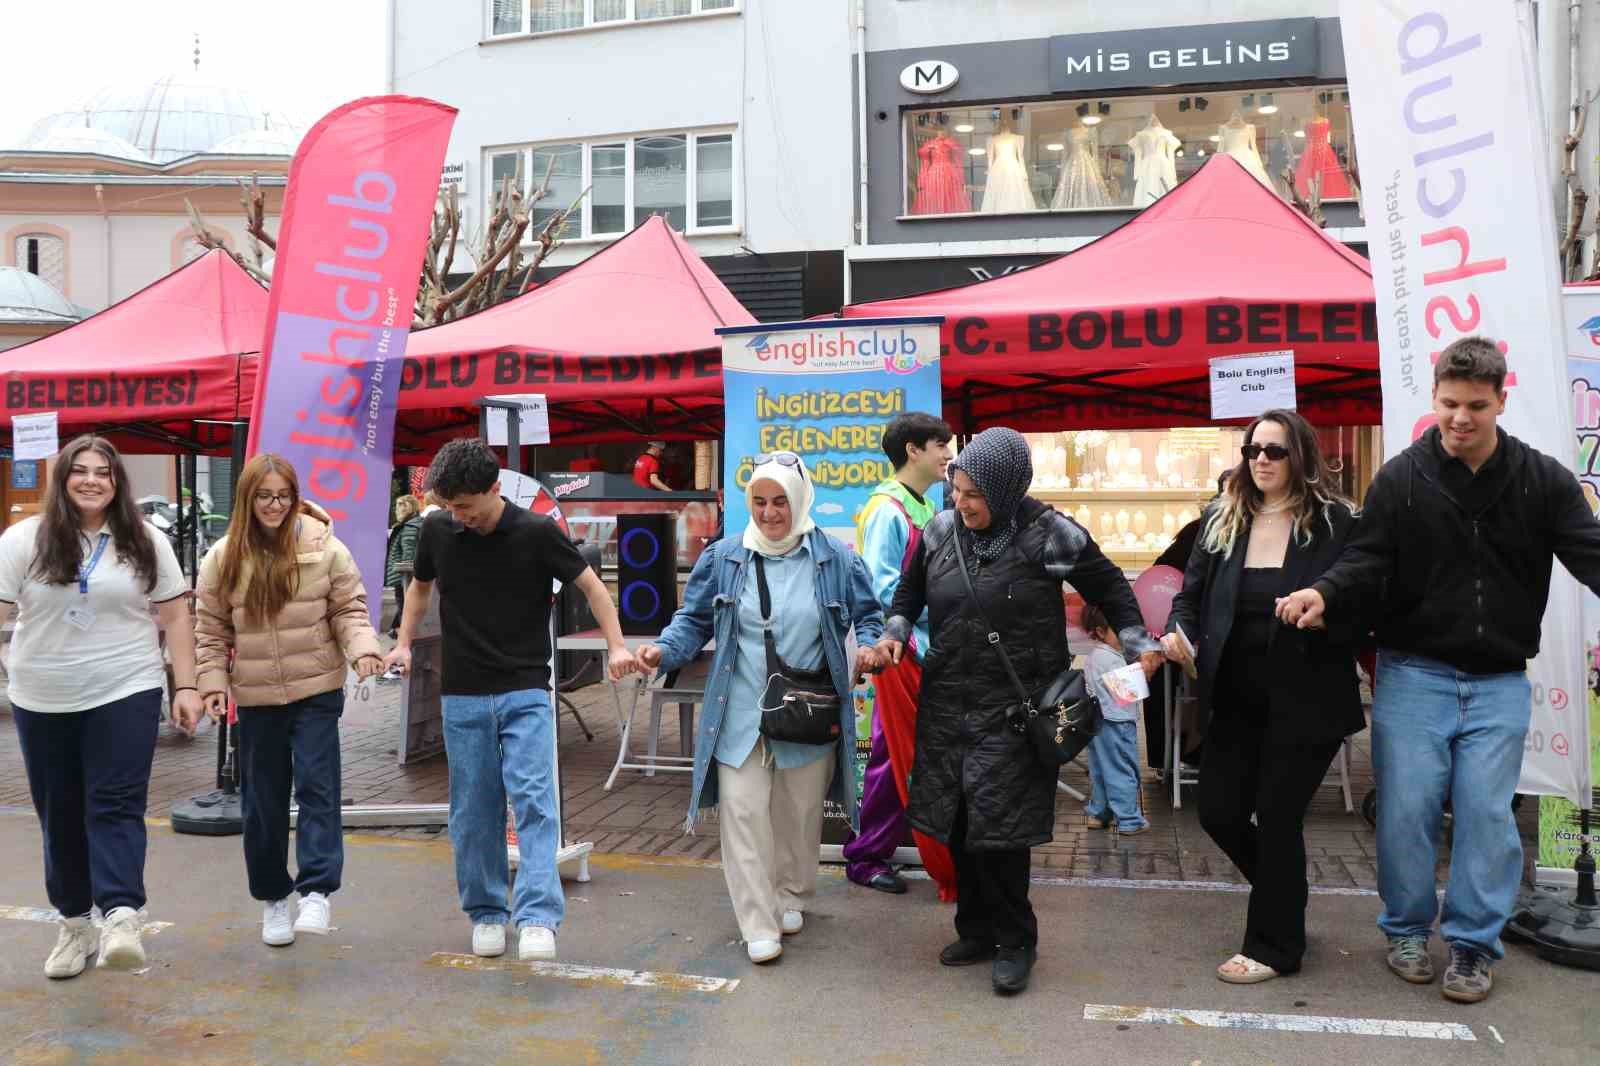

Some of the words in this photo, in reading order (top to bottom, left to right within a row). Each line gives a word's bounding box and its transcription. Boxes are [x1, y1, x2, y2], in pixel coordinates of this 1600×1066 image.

[378, 327, 392, 353] the
[1028, 308, 1182, 352] BOLU
[756, 329, 917, 366] englishclub
[372, 355, 386, 382] but
[400, 354, 480, 391] OLU
[1217, 370, 1242, 380] Bolu
[1245, 366, 1286, 379] English
[6, 370, 200, 409] BELEDİYESİ
[368, 384, 382, 420] easy
[1240, 383, 1265, 392] Club
[759, 424, 888, 453] EĞLENERE
